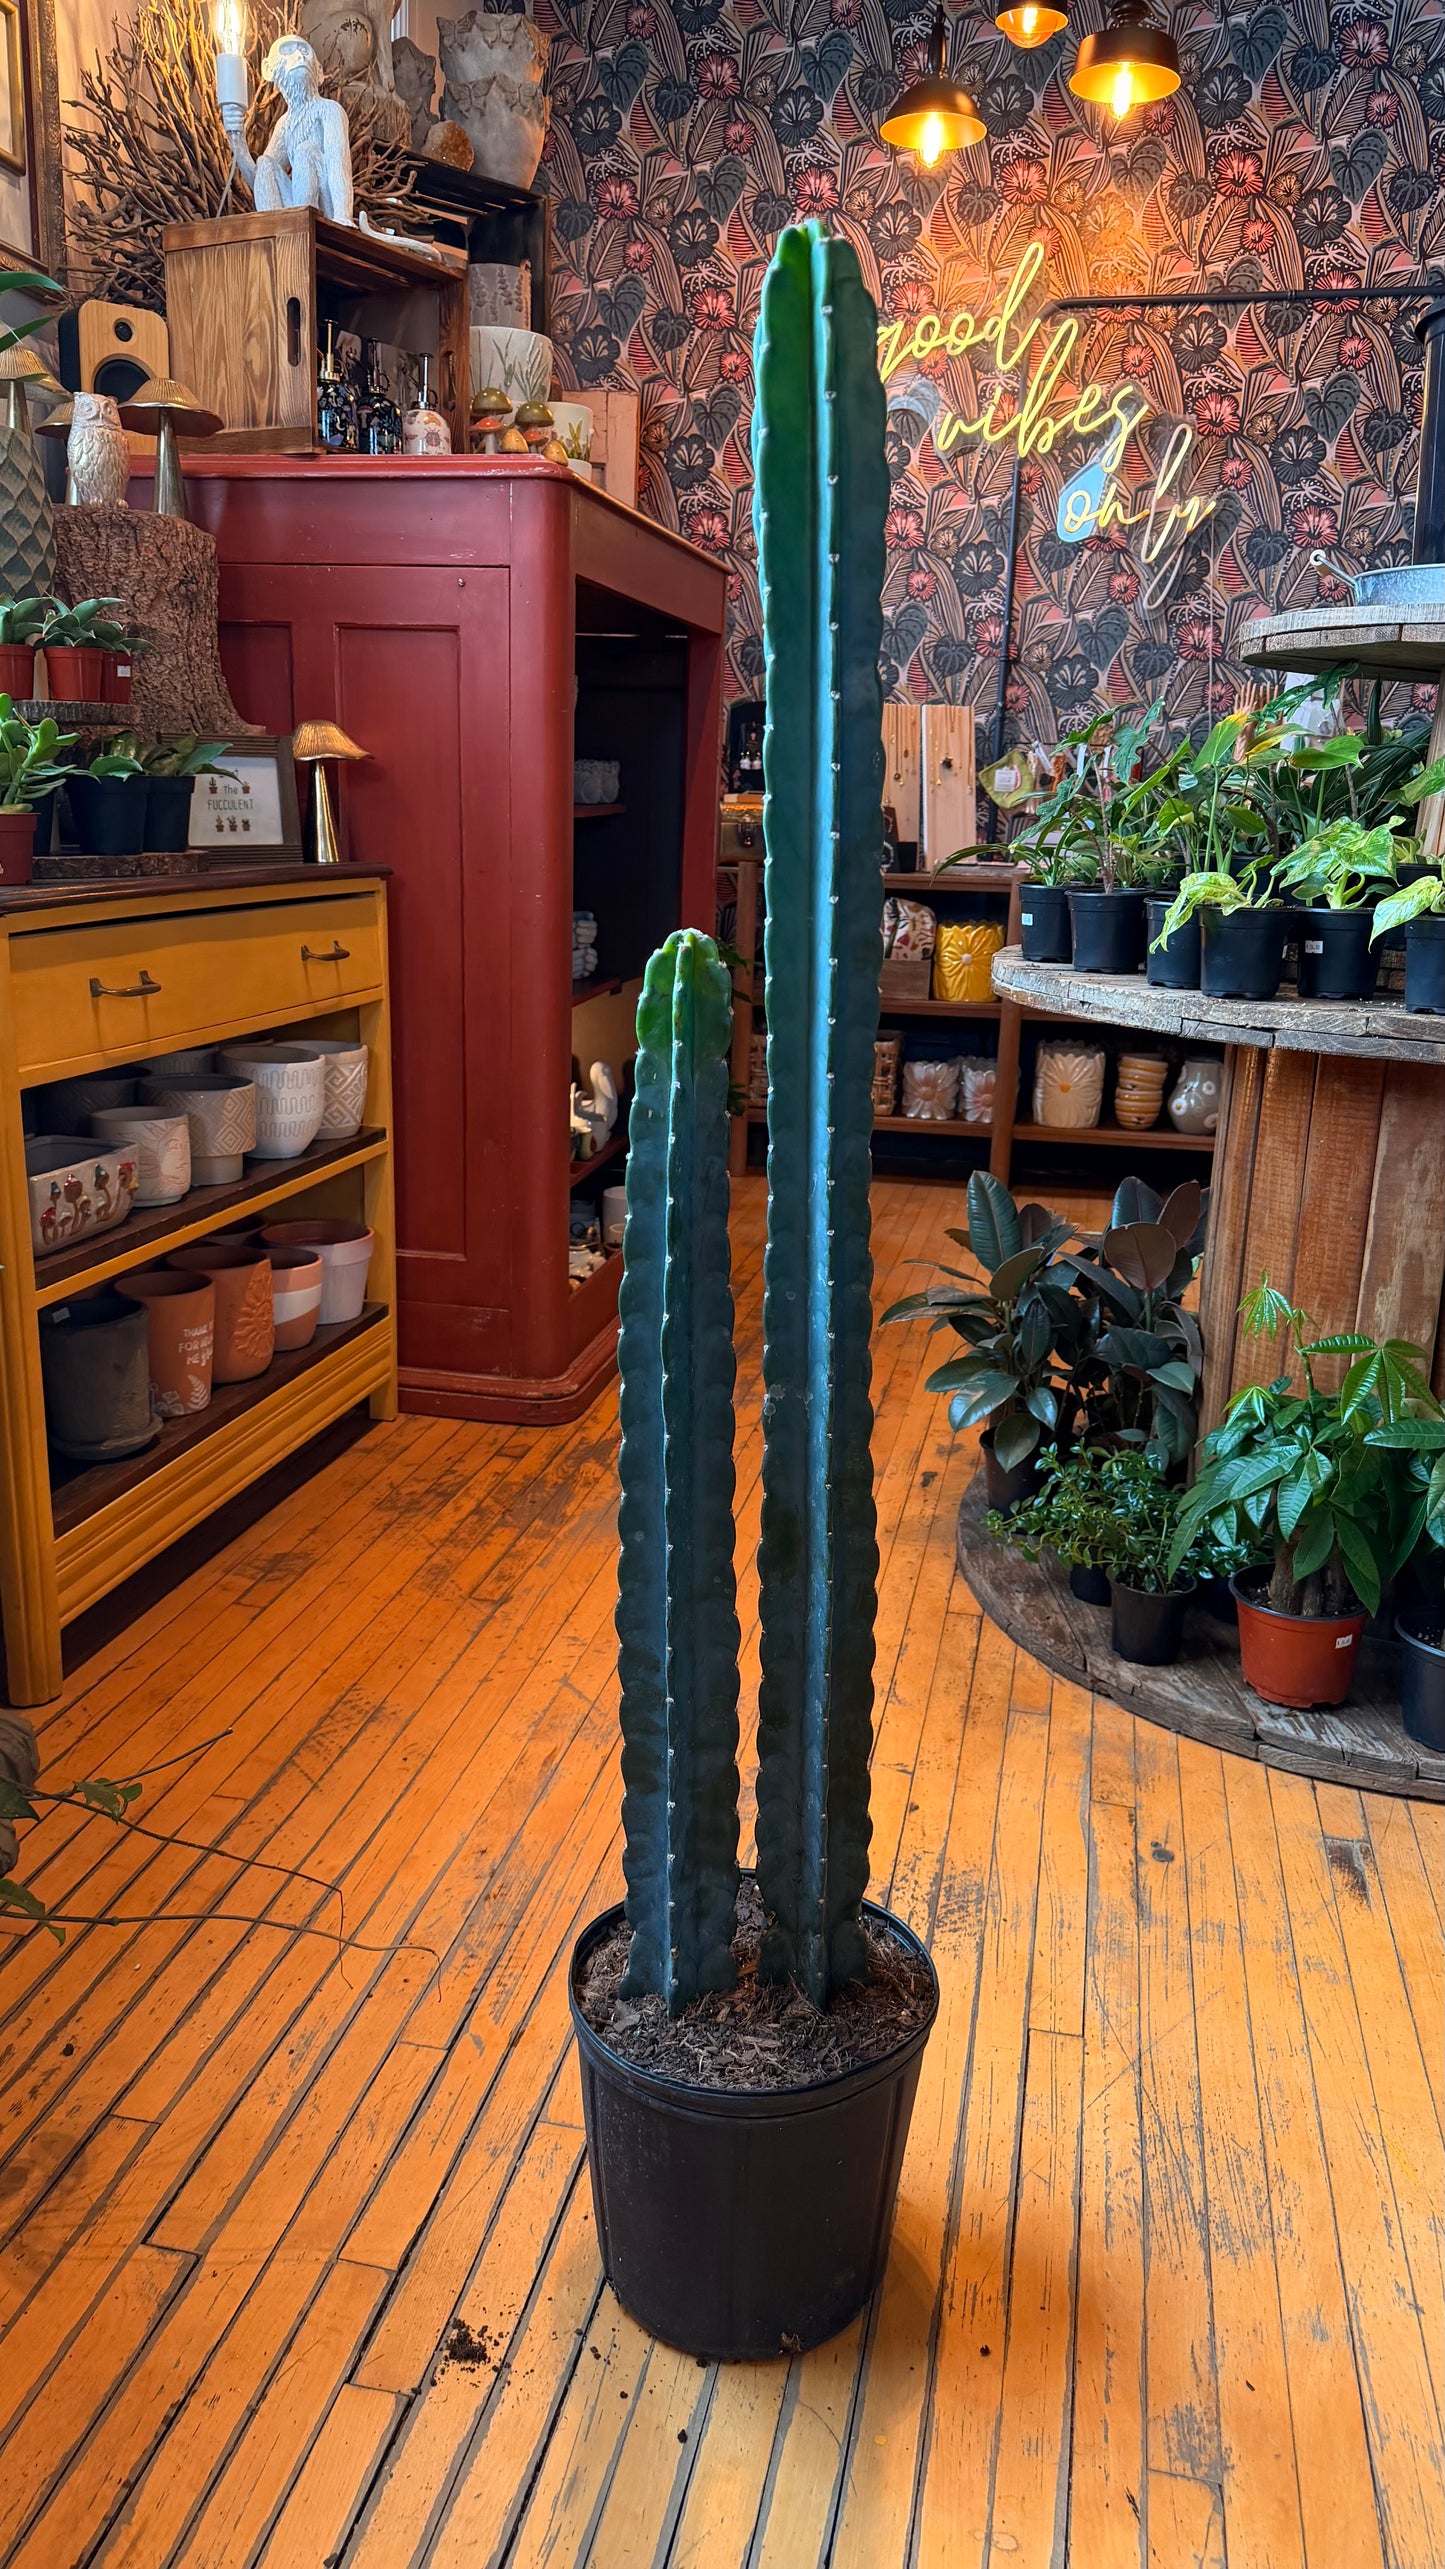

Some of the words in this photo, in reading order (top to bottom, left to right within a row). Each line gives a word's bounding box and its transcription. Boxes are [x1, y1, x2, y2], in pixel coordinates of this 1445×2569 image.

[937, 317, 1149, 474] vibes
[1062, 423, 1217, 610] only
[223, 784, 238, 795] the
[178, 1340, 199, 1353] FOR
